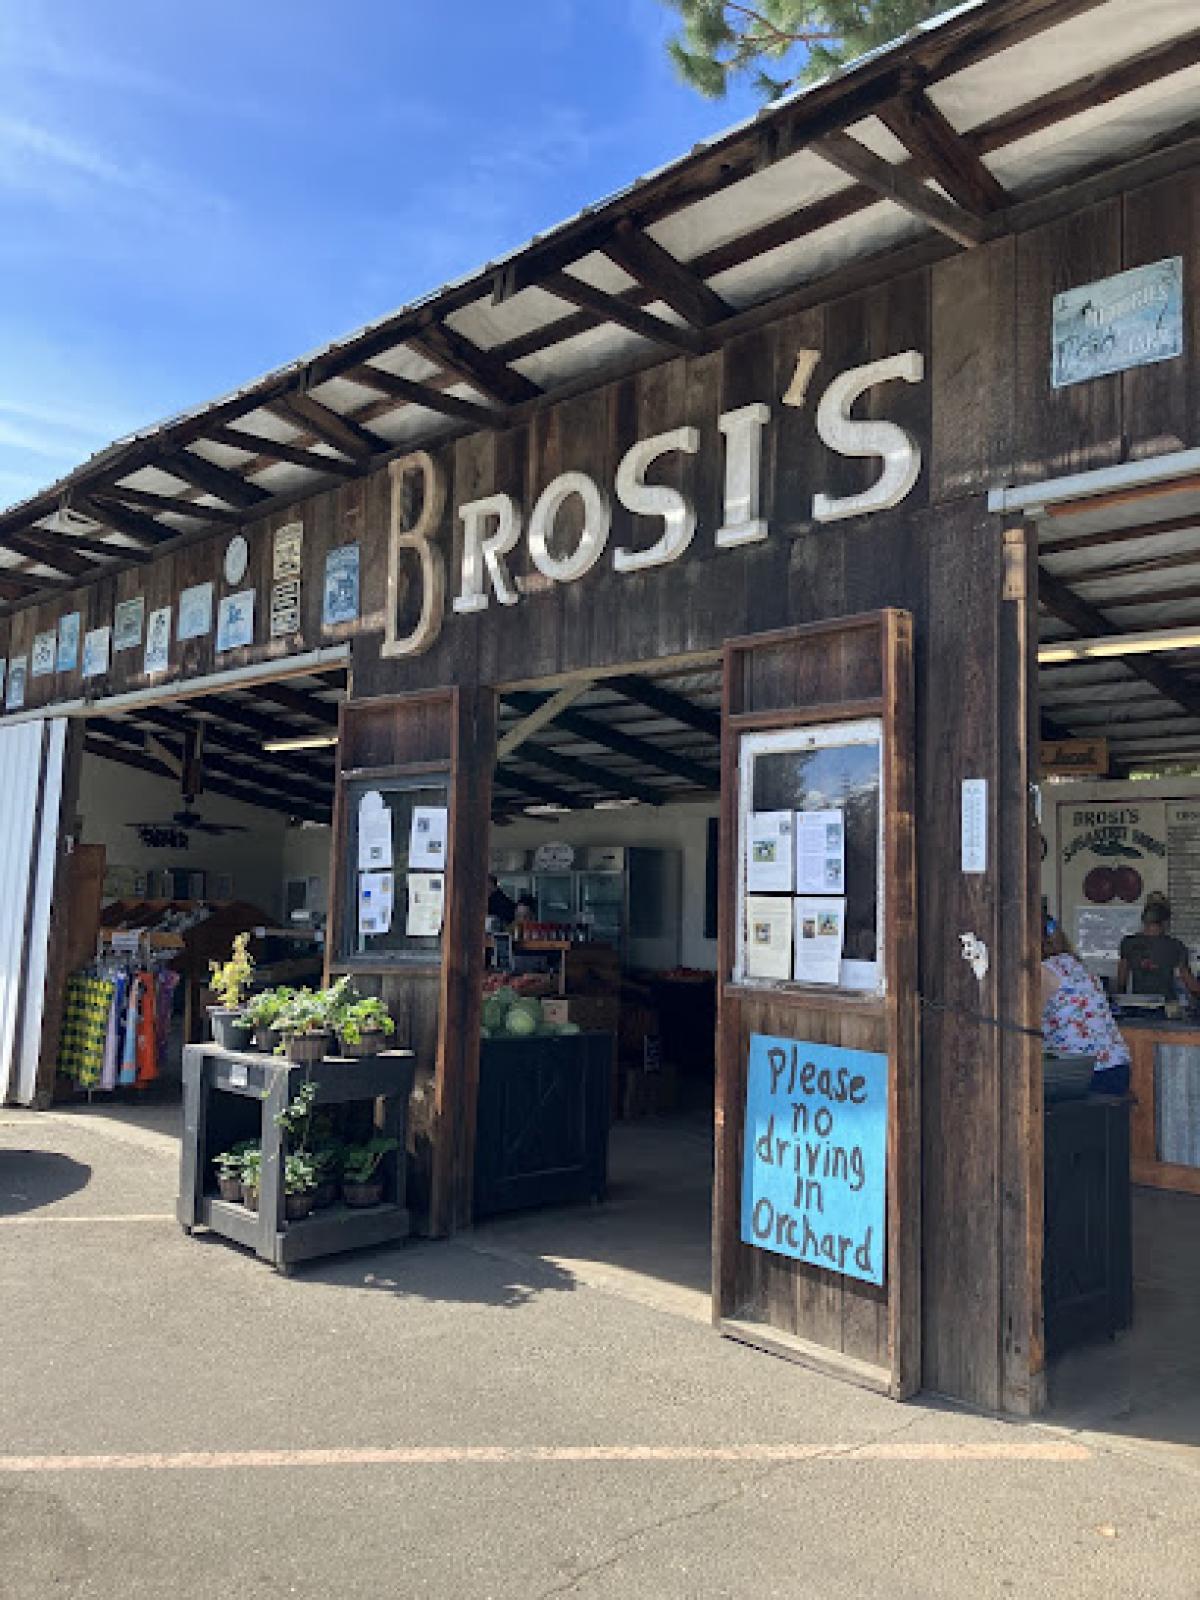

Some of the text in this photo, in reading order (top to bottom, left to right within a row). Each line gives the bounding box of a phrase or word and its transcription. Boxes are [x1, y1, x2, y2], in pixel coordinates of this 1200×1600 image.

[380, 349, 925, 659] BROSI'S
[767, 1044, 868, 1104] Please
[756, 1113, 865, 1192] driving
[791, 1102, 833, 1137] no
[752, 1196, 874, 1276] Orchard
